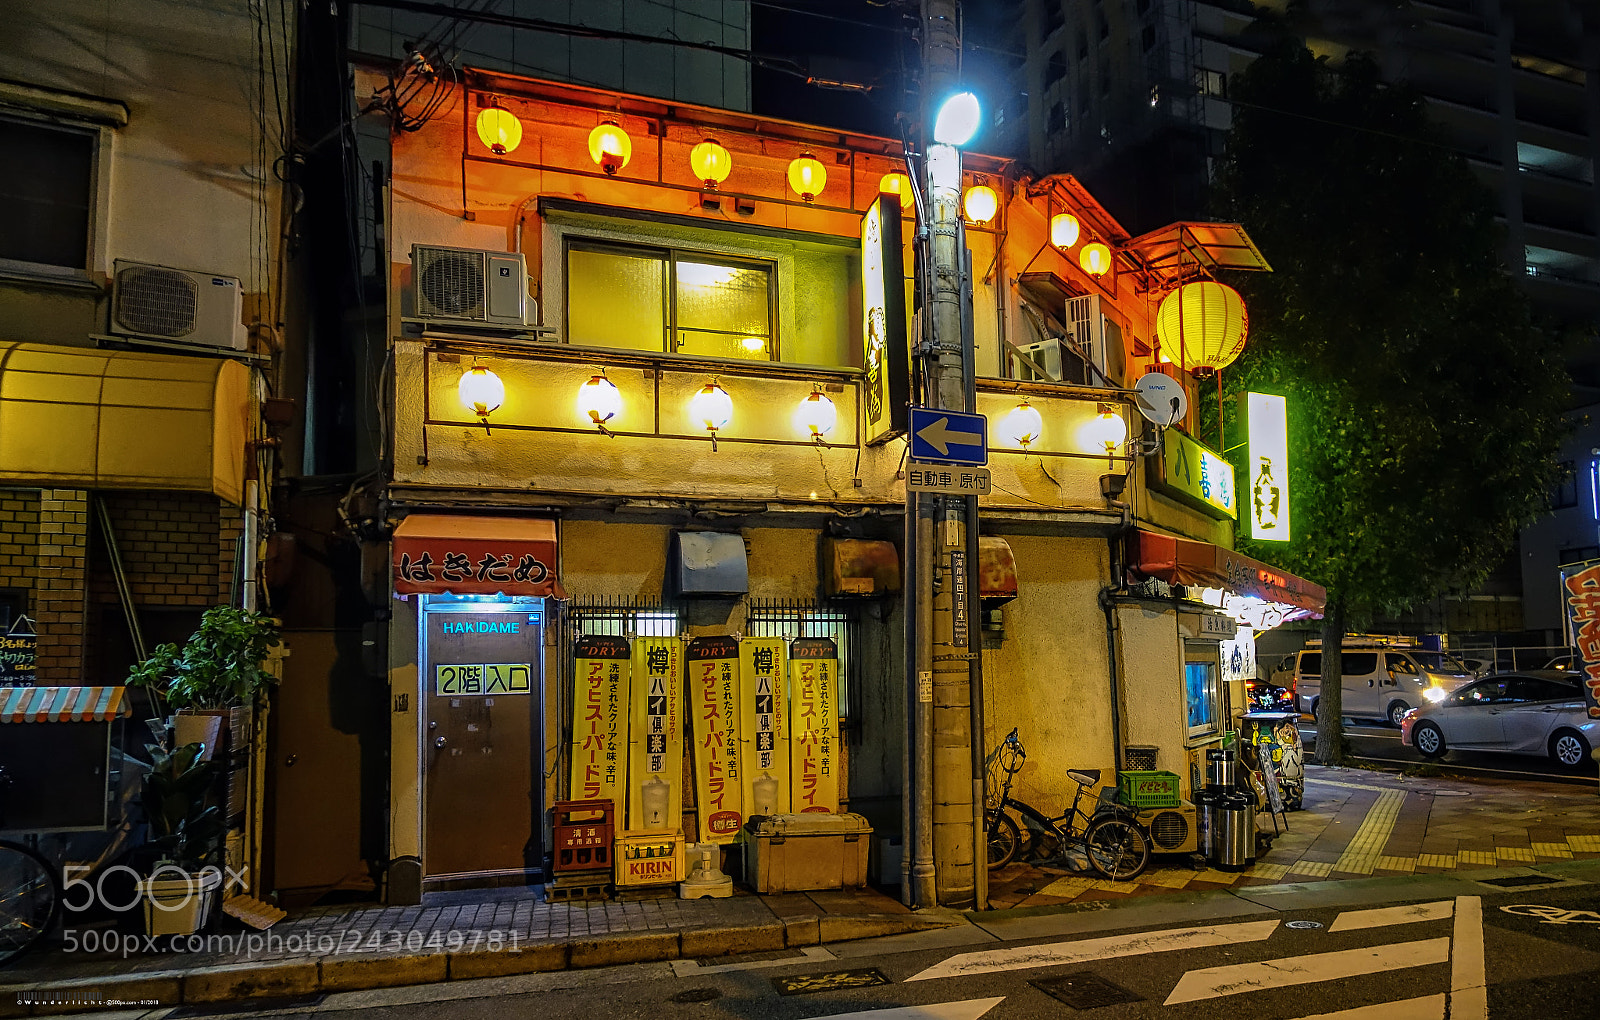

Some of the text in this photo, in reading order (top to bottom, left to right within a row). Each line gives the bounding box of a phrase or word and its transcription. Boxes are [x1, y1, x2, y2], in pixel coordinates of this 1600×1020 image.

[399, 551, 549, 584] はきだめ
[443, 622, 520, 634] HAKIDAME
[441, 666, 529, 694] 2階入口
[647, 646, 669, 771] 樽ハイ倶楽部
[752, 646, 775, 769] 樽ハイ倶楽部
[701, 663, 725, 809] アサヒスーパードライ
[800, 663, 820, 805] アサヒスーパードライ
[629, 860, 672, 875] KIRIN
